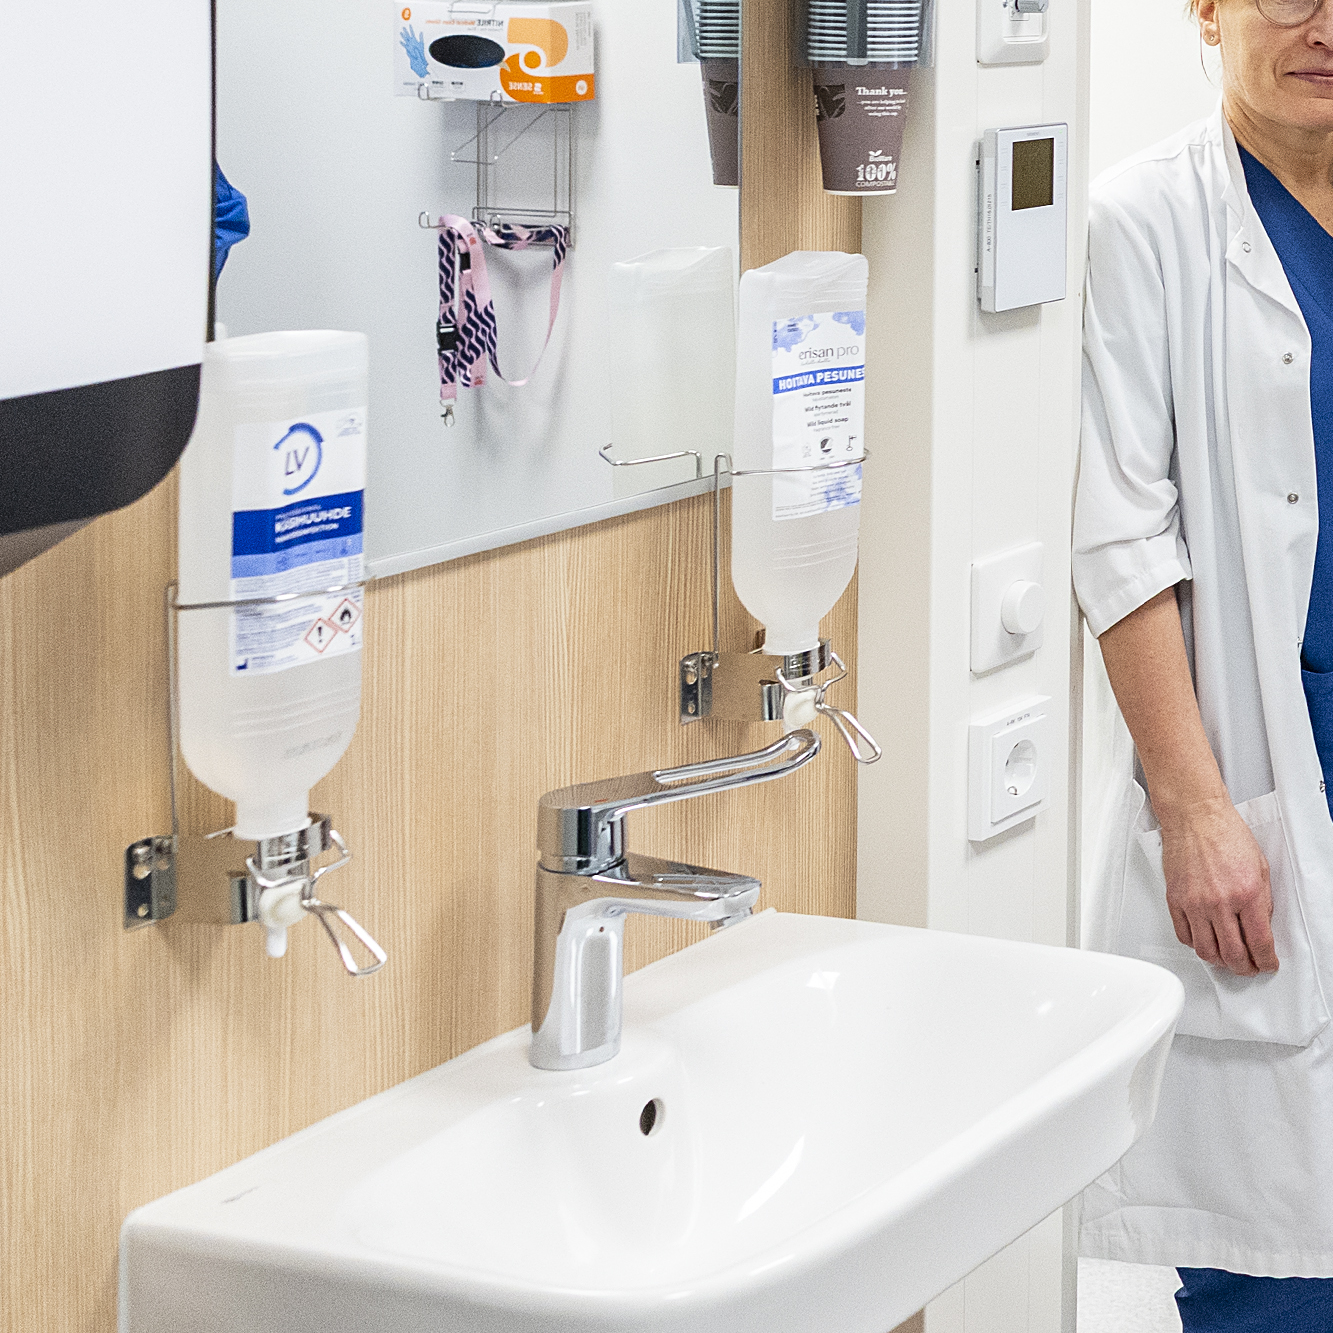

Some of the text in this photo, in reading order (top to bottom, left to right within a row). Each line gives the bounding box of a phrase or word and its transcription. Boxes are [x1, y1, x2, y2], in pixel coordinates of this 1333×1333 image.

[855, 86, 888, 96] Thank
[855, 162, 897, 181] 100%
[798, 345, 860, 361] erisan pro
[778, 373, 816, 391] HOITAVA
[284, 445, 310, 476] LV
